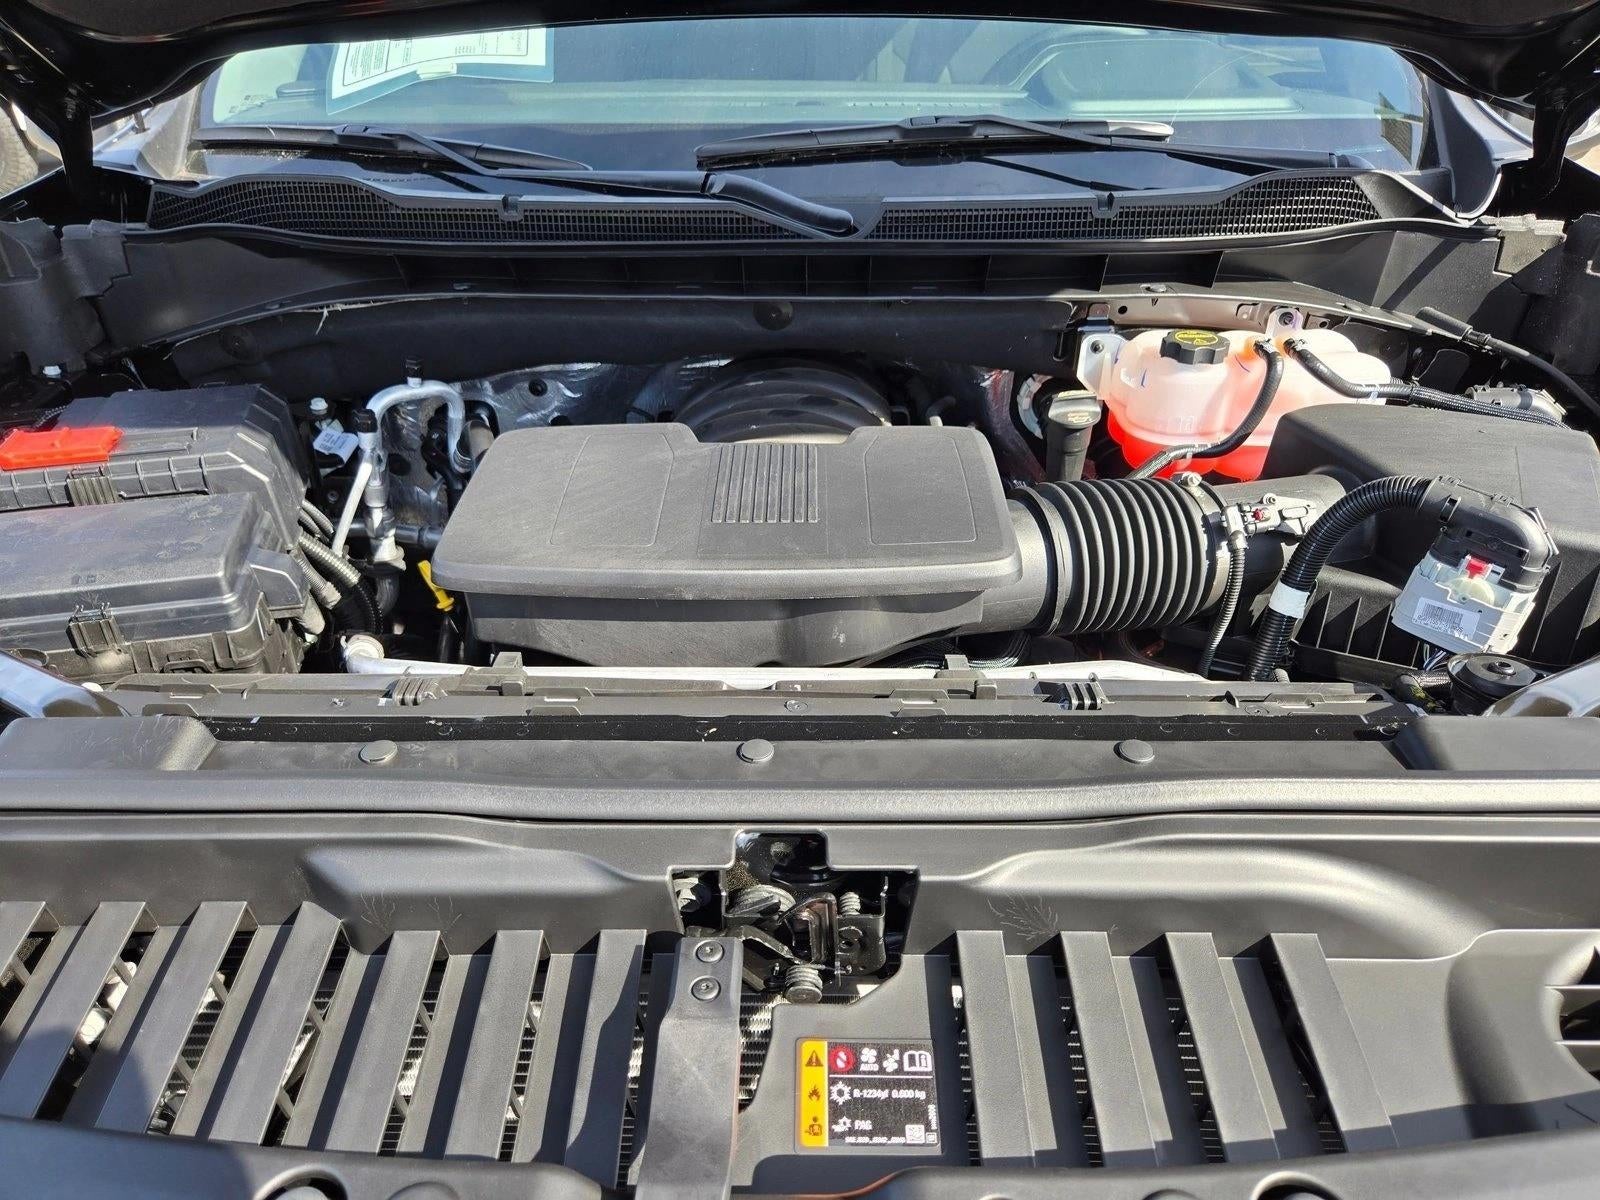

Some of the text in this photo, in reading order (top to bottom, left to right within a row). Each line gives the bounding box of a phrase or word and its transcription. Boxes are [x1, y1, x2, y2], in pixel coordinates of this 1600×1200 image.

[860, 1063, 879, 1071] AUTO
[853, 1088, 889, 1100] R-1234yf
[914, 1089, 926, 1100] kg
[854, 1120, 872, 1130] PAG
